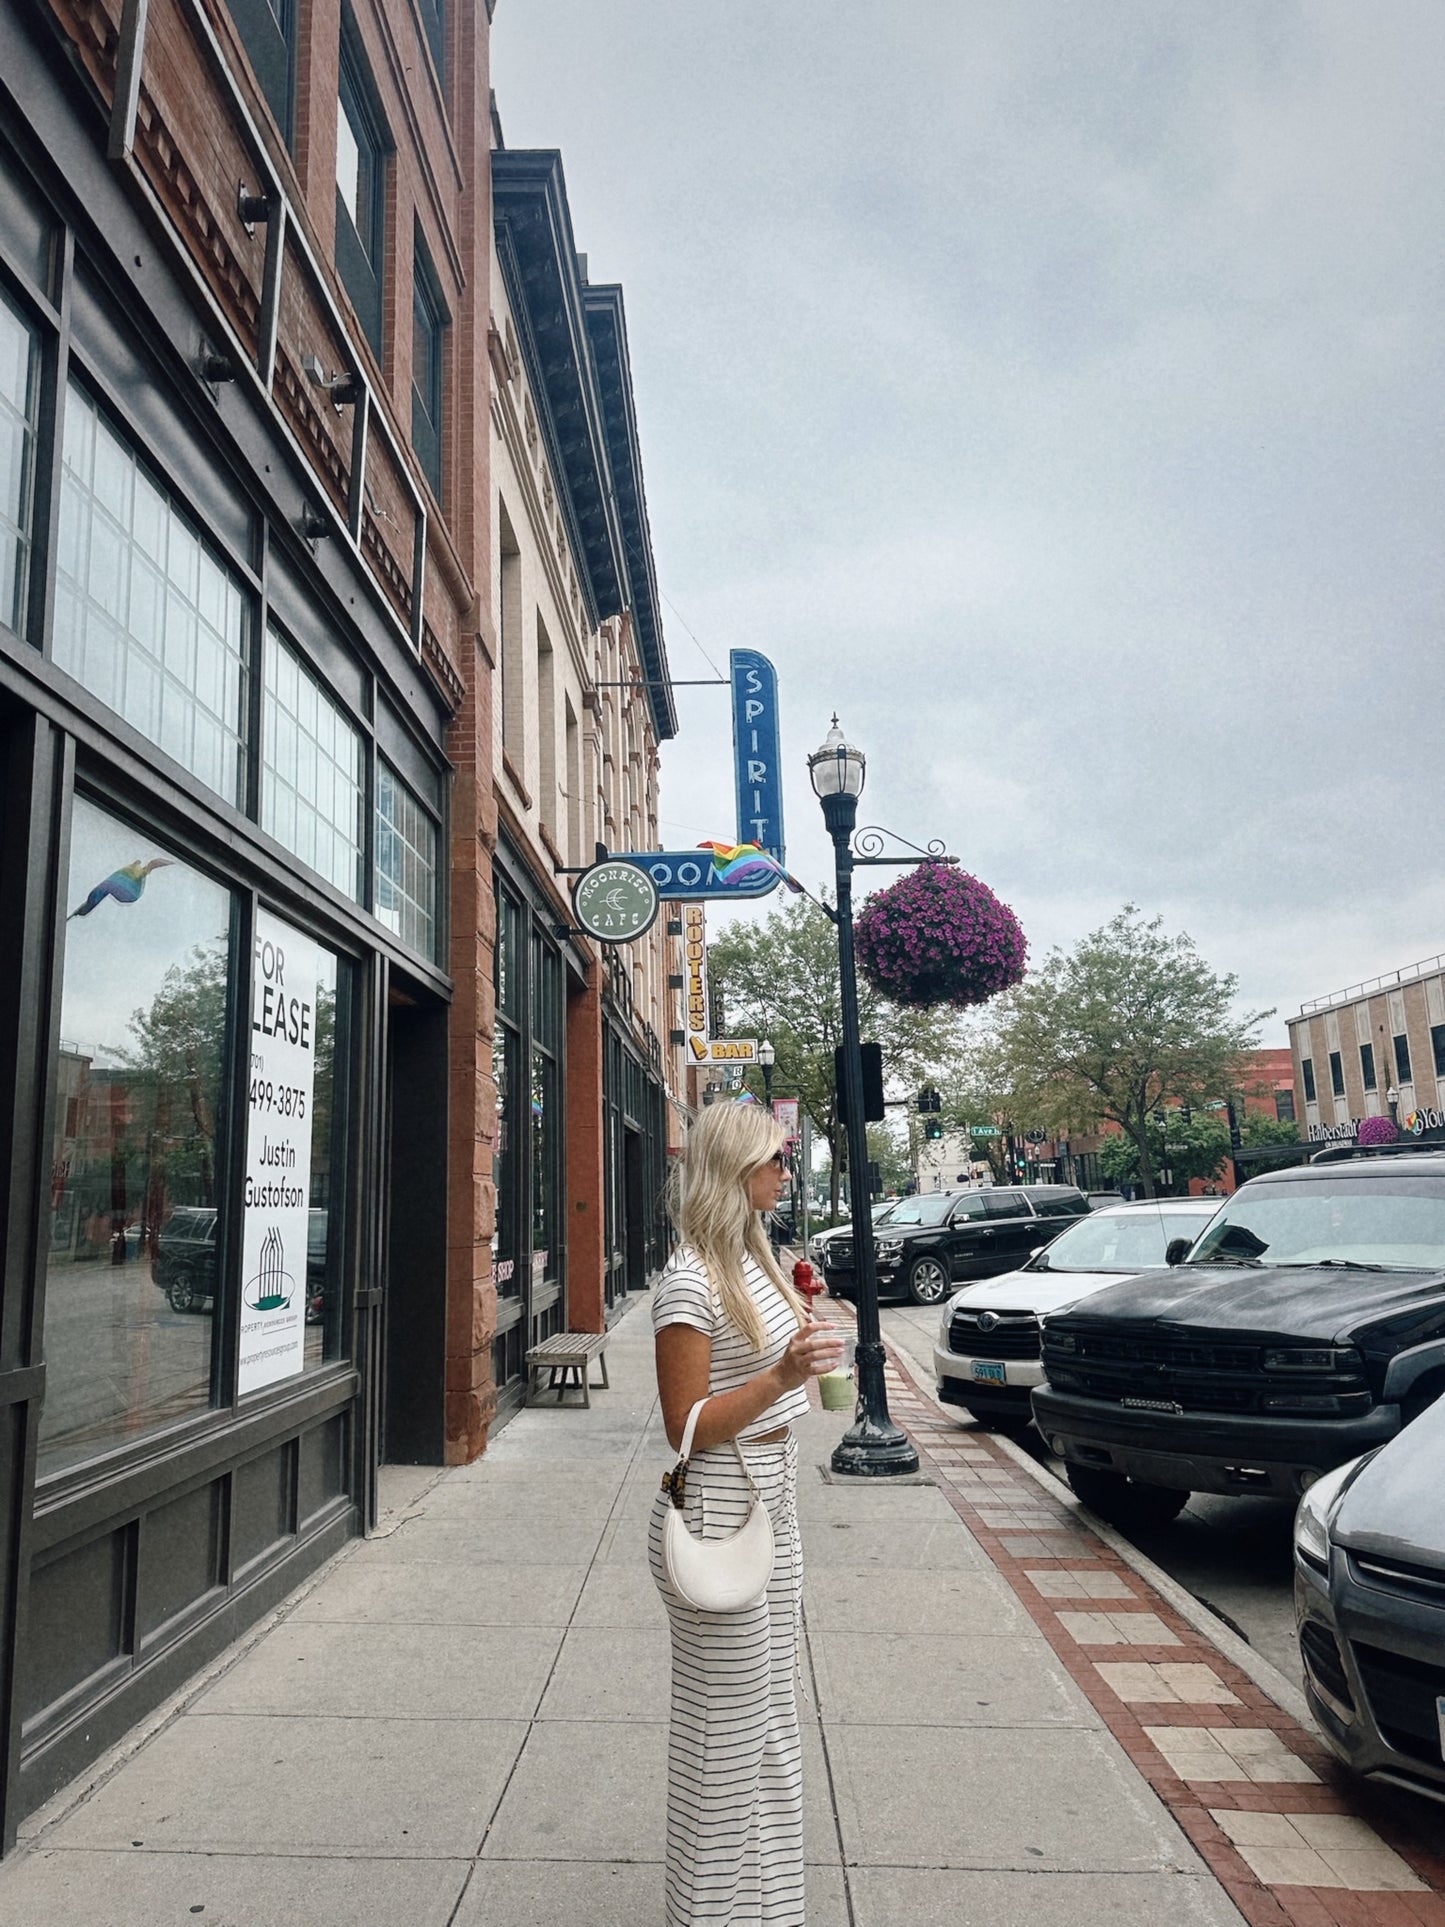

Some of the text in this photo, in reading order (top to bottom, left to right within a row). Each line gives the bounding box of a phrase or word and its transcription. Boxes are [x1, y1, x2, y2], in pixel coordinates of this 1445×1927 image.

[746, 670, 769, 843] SPIRIT
[581, 870, 649, 899] MOONRISE
[592, 912, 640, 927] CAFE
[686, 907, 705, 1032] ROOTERS
[711, 1043, 754, 1060] BAR
[249, 1078, 306, 1119] 499-3875
[978, 1127, 994, 1135] Ave
[259, 1135, 296, 1168] Justin
[244, 1176, 304, 1208] Gustofson
